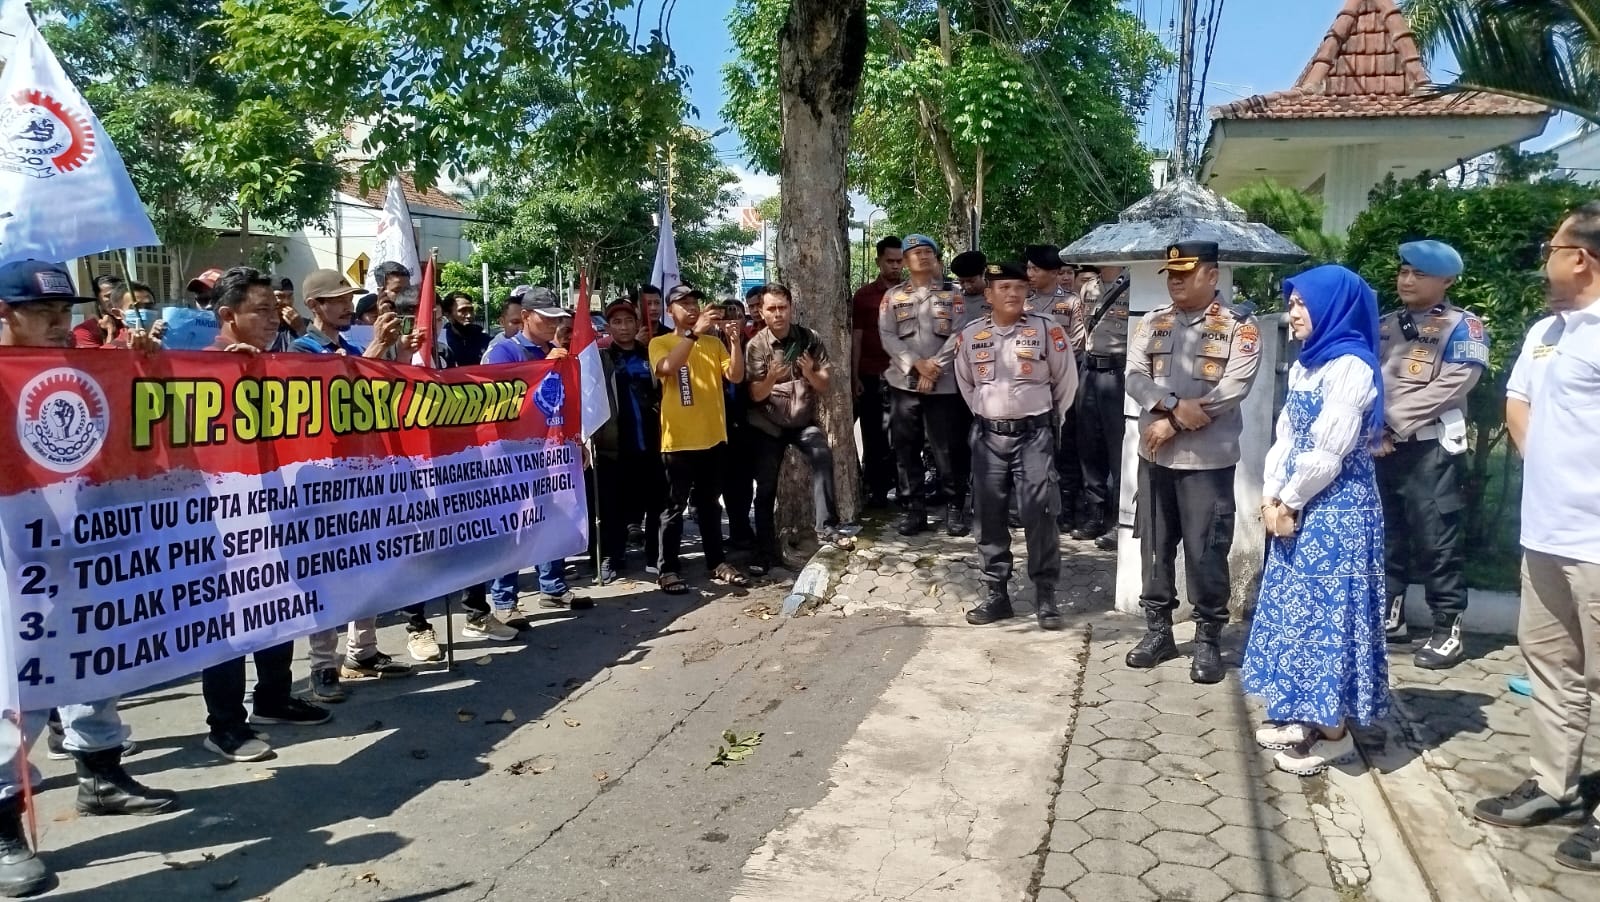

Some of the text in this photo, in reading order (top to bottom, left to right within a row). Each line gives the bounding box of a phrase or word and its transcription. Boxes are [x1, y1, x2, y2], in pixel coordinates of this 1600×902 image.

[1151, 330, 1172, 338] ARDI
[1200, 332, 1229, 343] POLRI
[133, 376, 528, 449] PTP. SBPJ GSBI JOMBANG
[546, 416, 564, 426] GSBI
[21, 472, 576, 598] 2, TOLAK PHK SEPIHAK DENGAN ALASAN PERUSAHAAN MERUGI.
[24, 447, 574, 548] 1. CABUT UU CIPTA KERJA TERBITKAN UU KETENAGAKERJAAN YANG BARU.
[19, 505, 546, 641] 3. TOLAK PESANGON DENGAN SISTEM DI CICIL 10 KALI.
[18, 591, 323, 686] 4. TOLAK UPAH MURAH.
